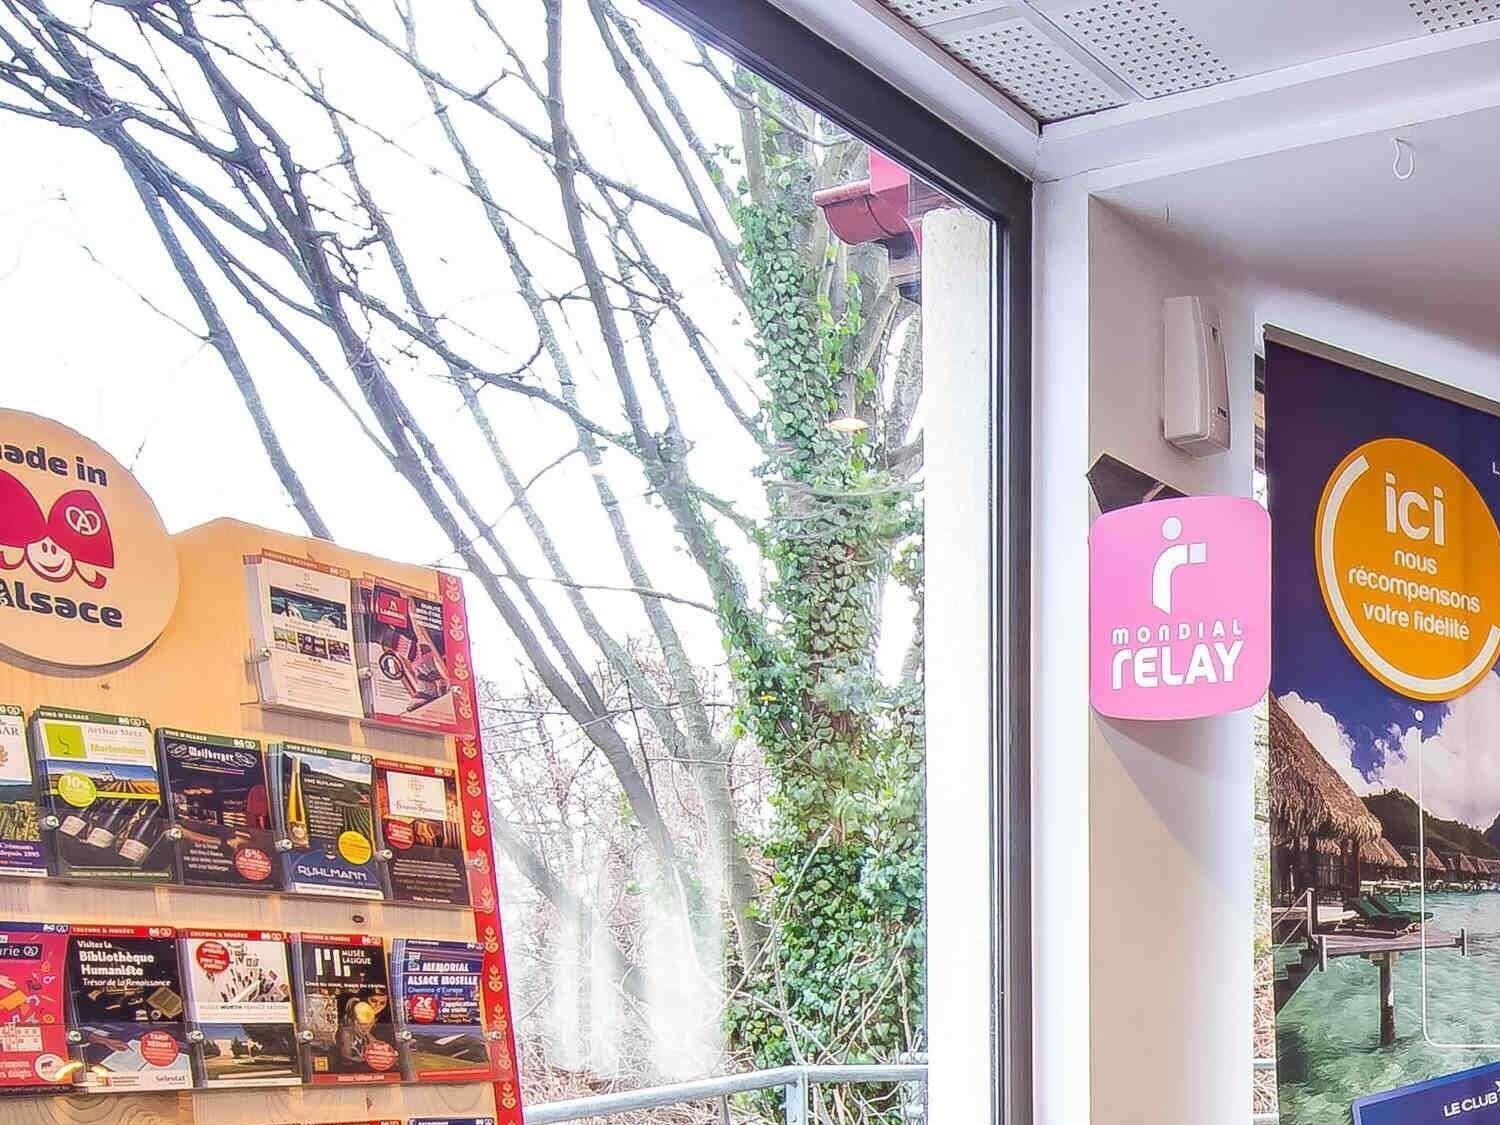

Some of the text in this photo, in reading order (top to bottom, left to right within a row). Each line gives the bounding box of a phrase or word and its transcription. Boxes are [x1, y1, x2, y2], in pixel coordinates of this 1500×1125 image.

[0, 444, 107, 486] ade in
[1385, 472, 1446, 546] ici
[1393, 548, 1438, 575] nous
[1348, 566, 1481, 614] récompensons
[1362, 602, 1471, 642] votre fidélité
[87, 727, 118, 735] Arthur
[298, 866, 367, 881] RUHLMANN
[77, 940, 103, 948] Visitez
[79, 951, 154, 964] Bibliothèque
[81, 964, 143, 975] Humaniste
[408, 976, 478, 985] ALSACE MOSELLE
[416, 997, 432, 1007] 2€
[1443, 1101, 1461, 1117] LE
[1462, 1092, 1498, 1113] CLUB
